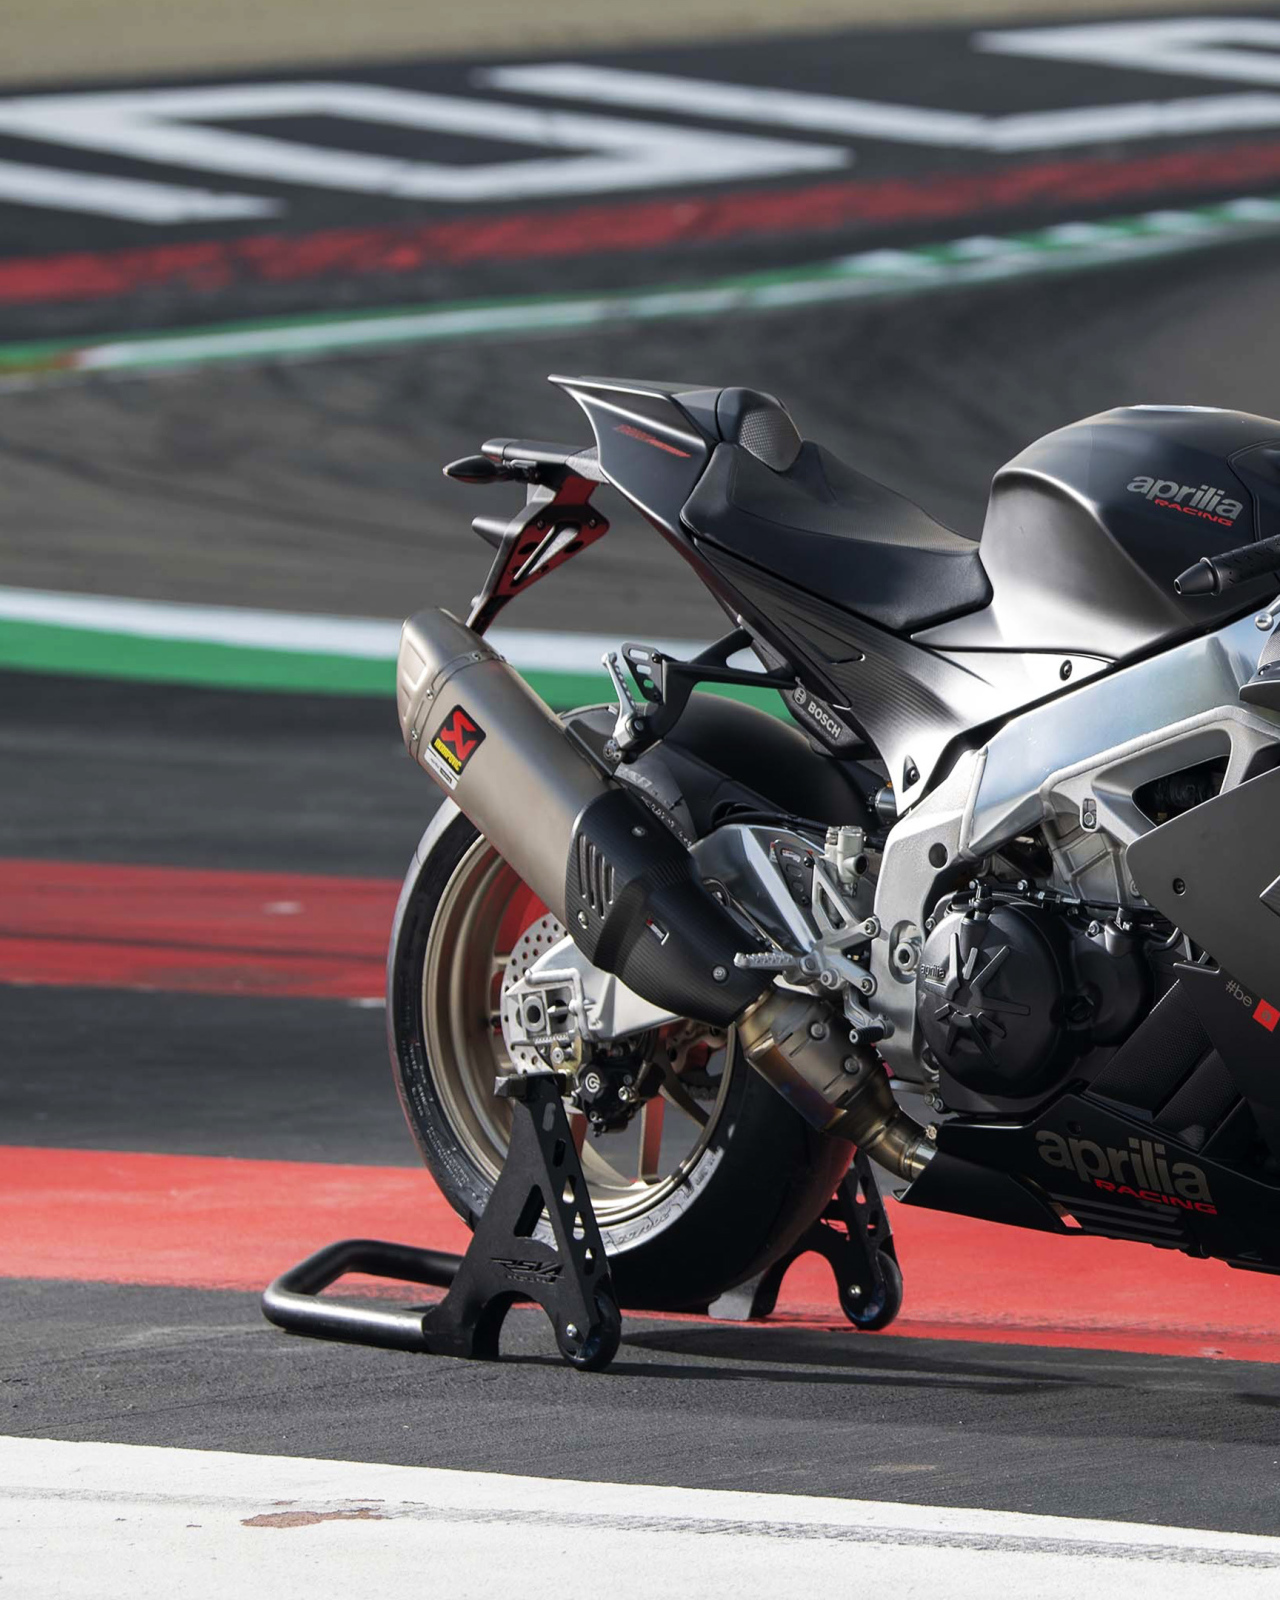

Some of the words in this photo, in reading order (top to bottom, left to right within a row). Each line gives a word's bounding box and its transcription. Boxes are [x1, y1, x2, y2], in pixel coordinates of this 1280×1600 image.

[1127, 475, 1243, 519] aprilia
[1154, 499, 1234, 527] RACING
[808, 701, 841, 738] BOSCH
[920, 964, 946, 979] aprilia
[1225, 979, 1252, 1007] #be
[1035, 1130, 1213, 1202] aprilia
[1094, 1178, 1217, 1215] RACING
